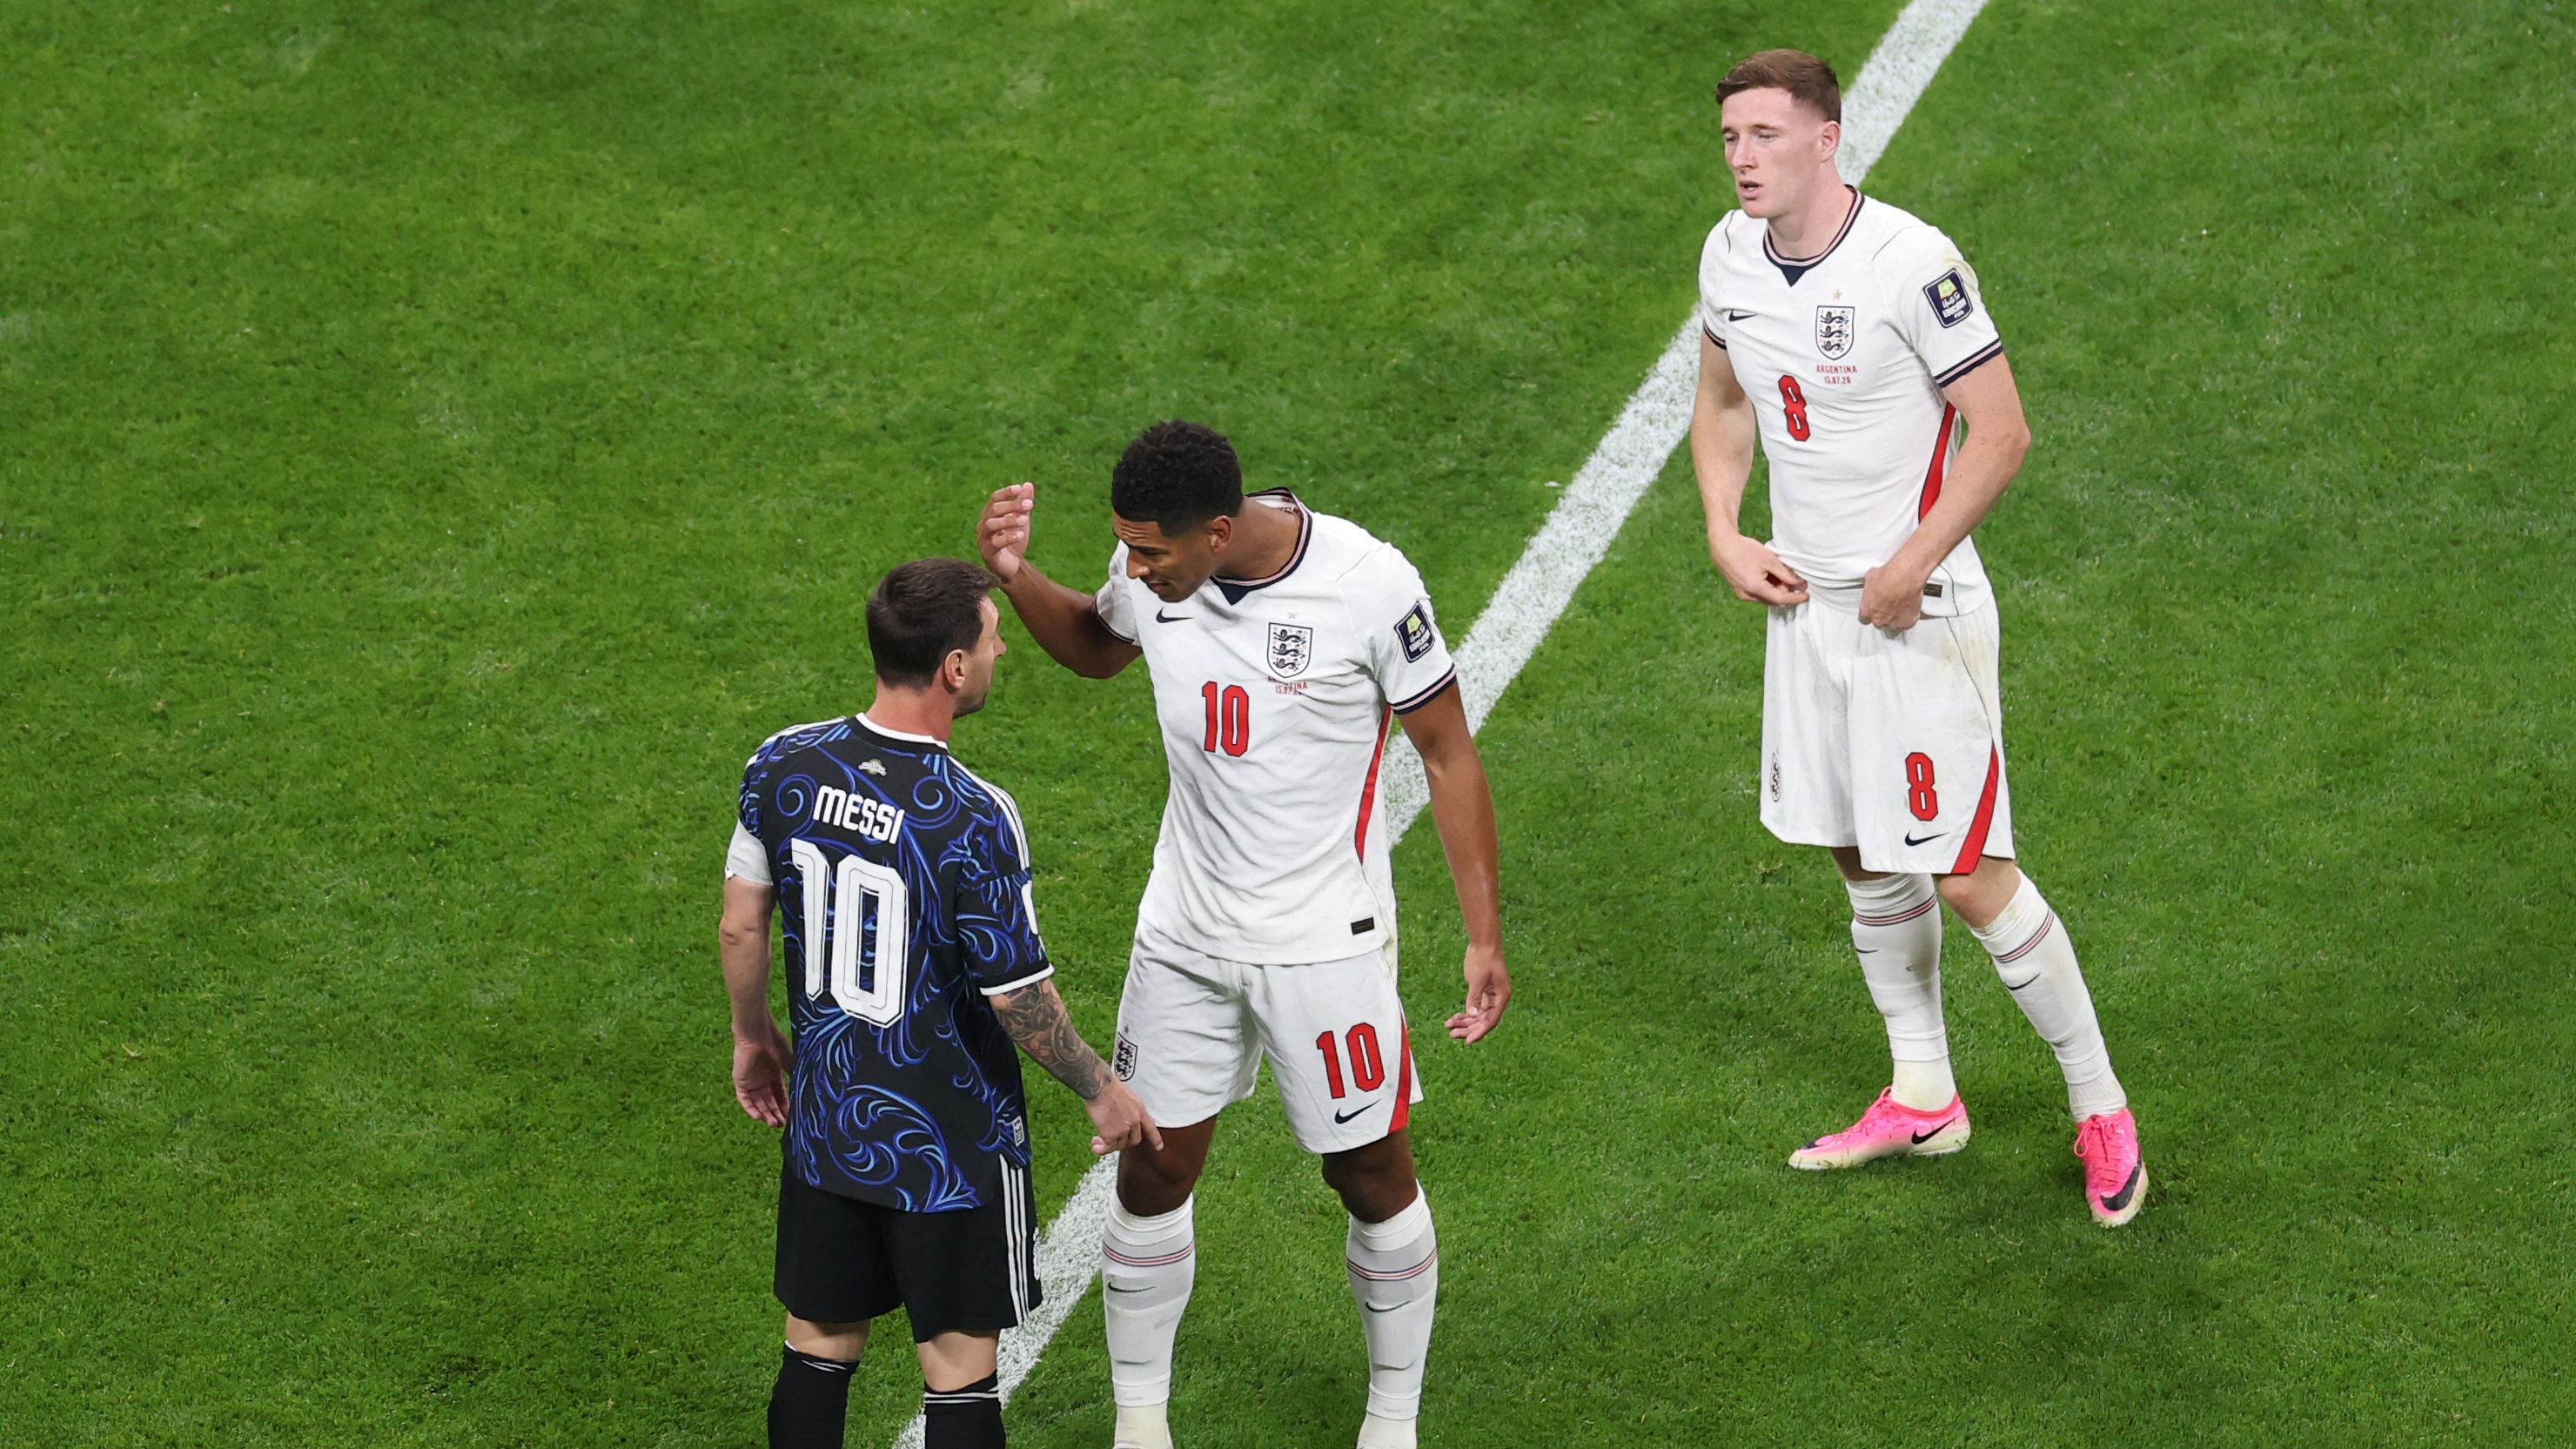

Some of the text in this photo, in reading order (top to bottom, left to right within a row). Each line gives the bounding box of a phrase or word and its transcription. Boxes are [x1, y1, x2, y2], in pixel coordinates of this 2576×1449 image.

[1816, 365, 1858, 374] ARGENTINA
[1778, 374, 1810, 441] 8
[1202, 681, 1249, 757] 10
[812, 785, 905, 845] MESSI
[1905, 752, 1939, 822] 8
[790, 837, 909, 1029] 10
[1316, 1023, 1385, 1099] 10
